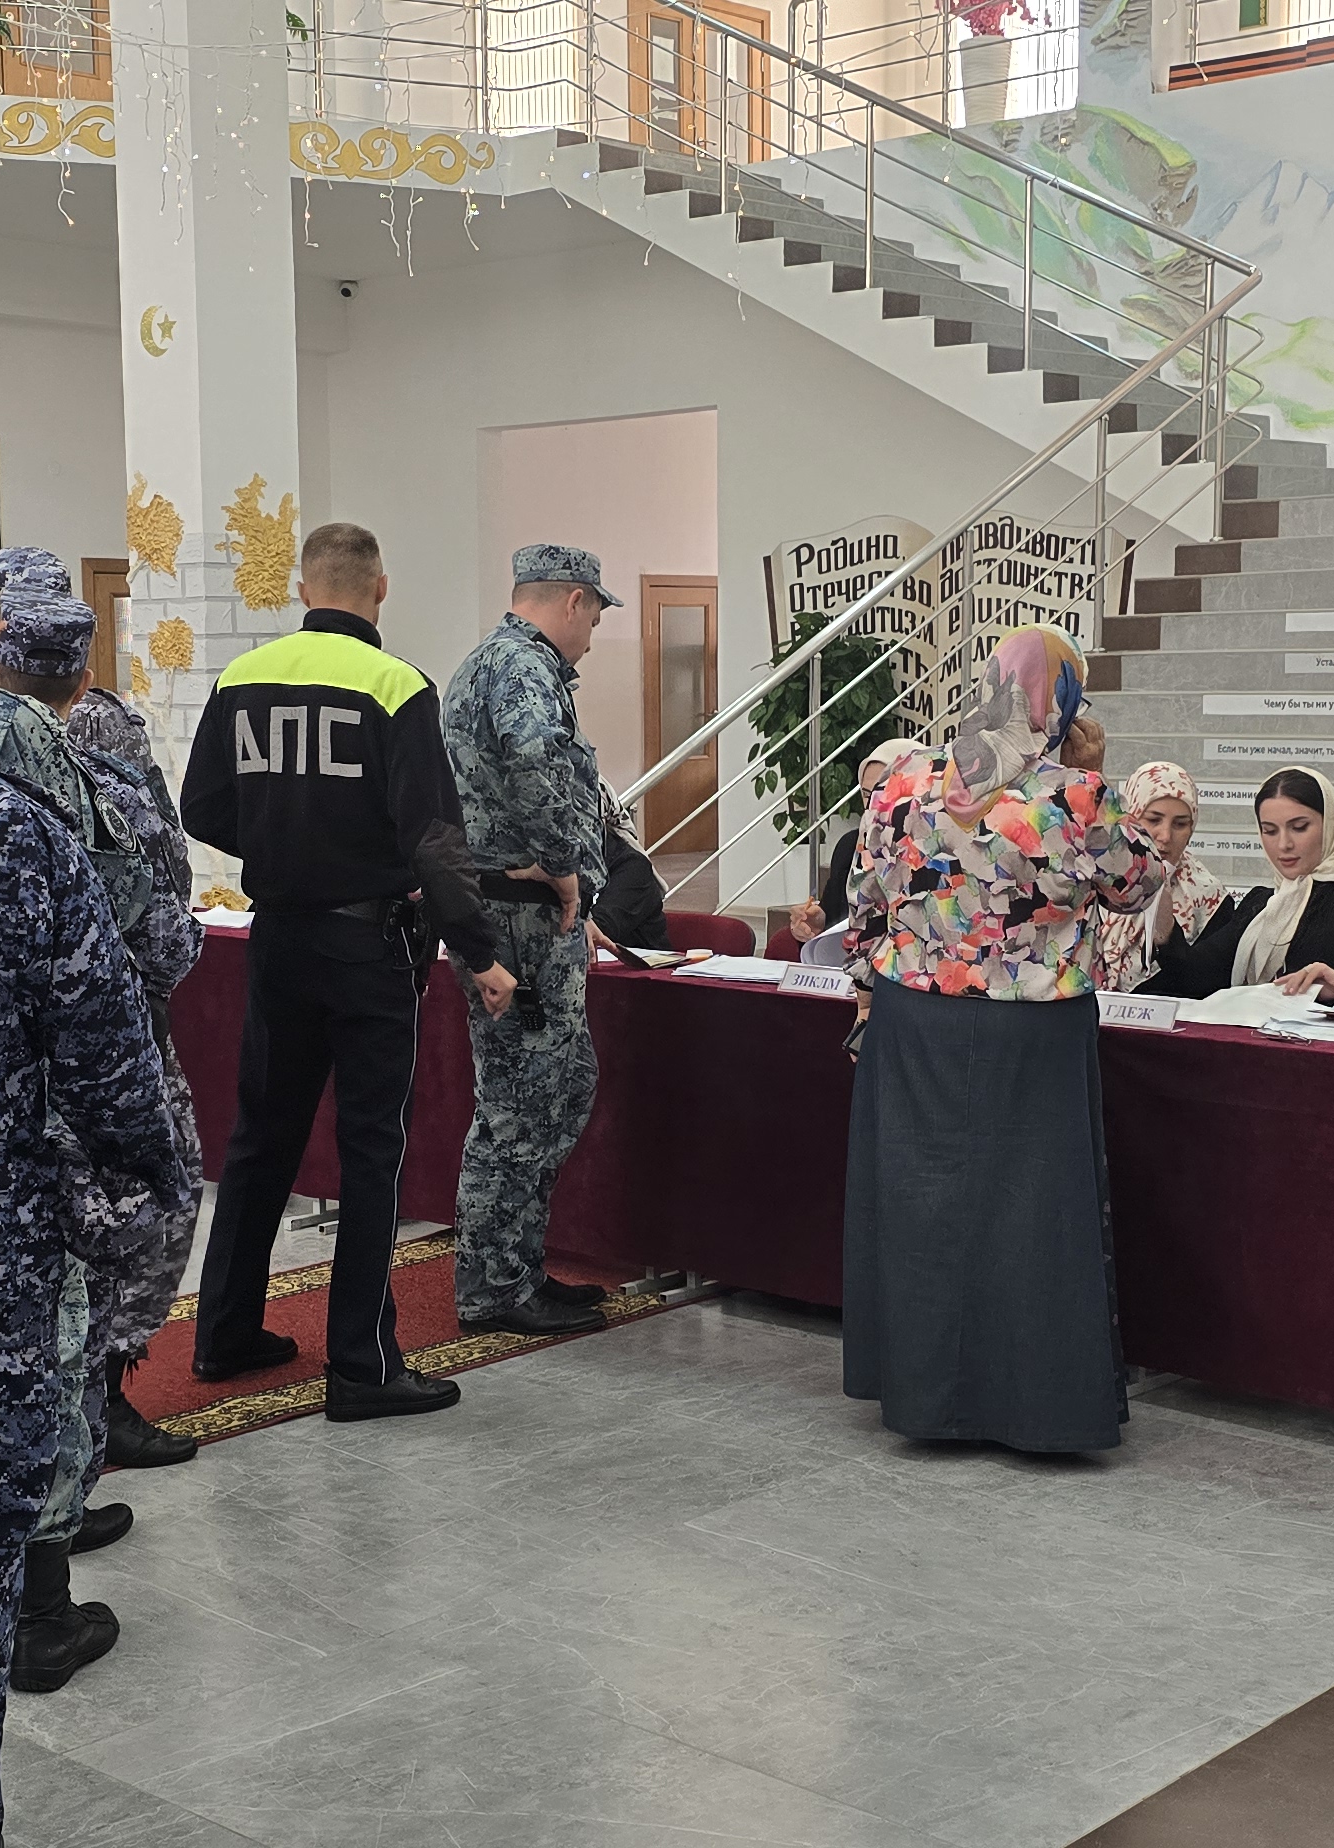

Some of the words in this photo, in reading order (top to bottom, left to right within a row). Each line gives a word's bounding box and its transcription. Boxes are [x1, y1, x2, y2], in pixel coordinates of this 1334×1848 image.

[1264, 699, 1286, 710] Чему
[1288, 699, 1301, 708] бы
[1302, 700, 1313, 708] ты
[1316, 700, 1326, 708] ни
[236, 705, 363, 777] ДПС
[1218, 744, 1236, 754] Если
[1250, 746, 1265, 756] уже
[1267, 747, 1293, 756] начал,
[1295, 748, 1324, 757] значит,
[1232, 841, 1251, 850] твой
[792, 973, 842, 991] ЗИКЛМ
[1104, 1004, 1155, 1021] ГДЕЖ
